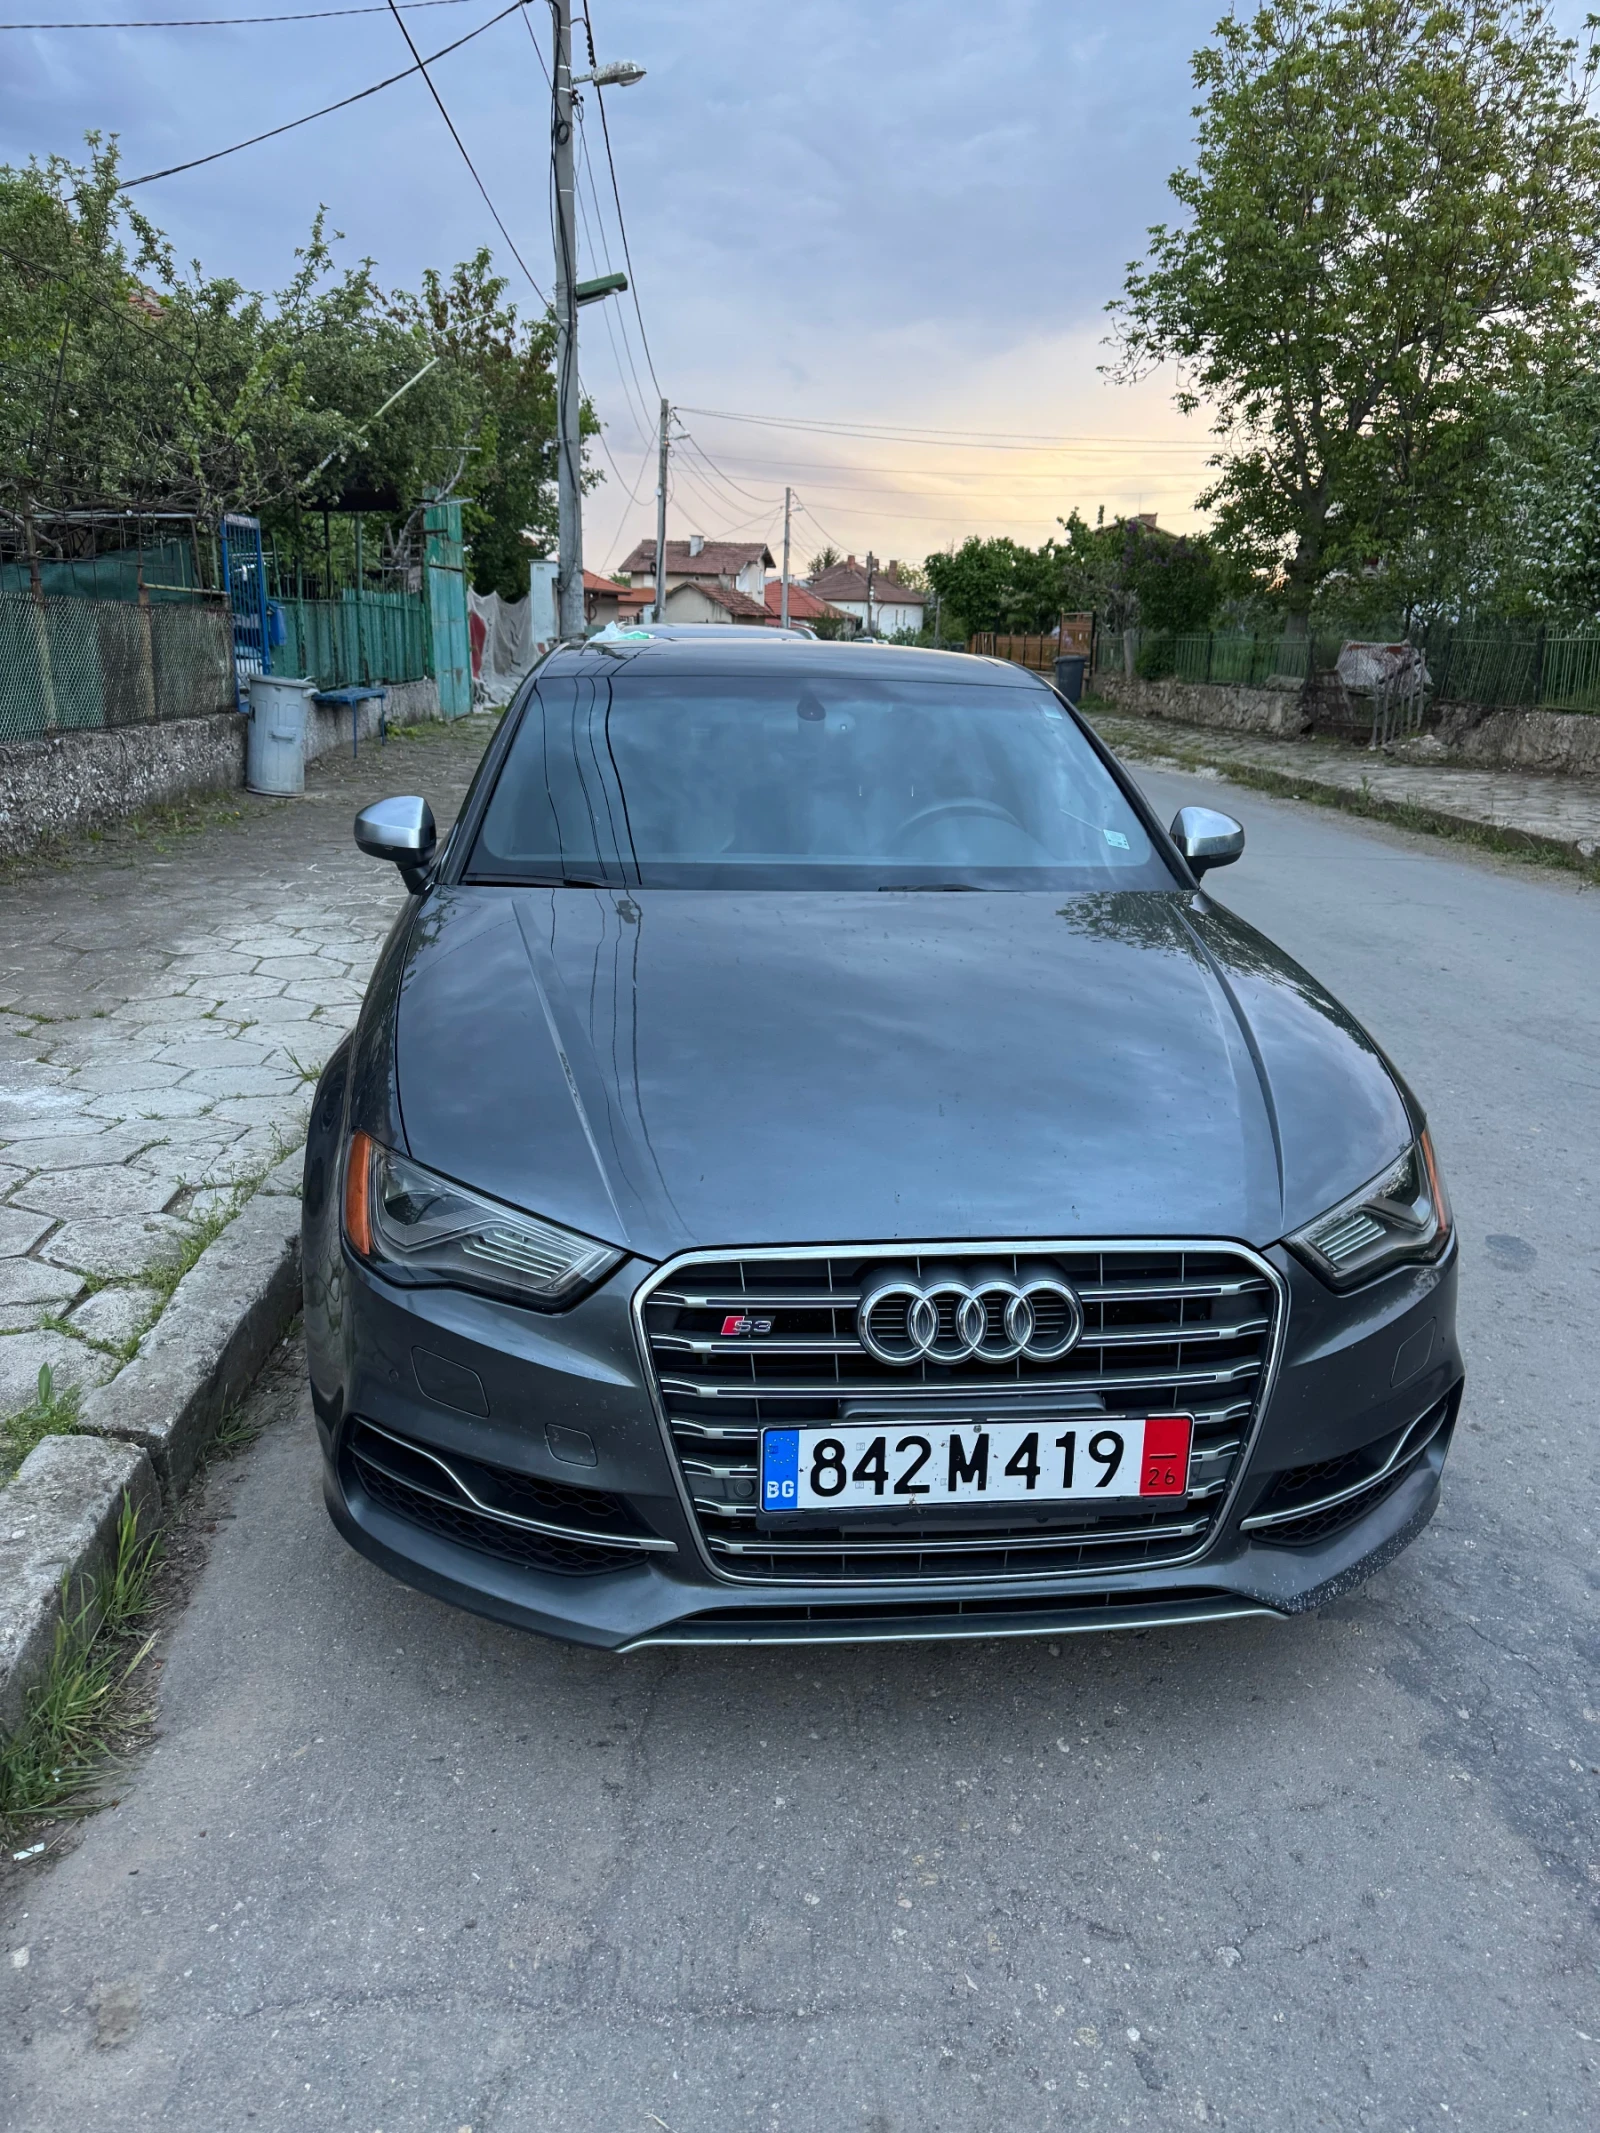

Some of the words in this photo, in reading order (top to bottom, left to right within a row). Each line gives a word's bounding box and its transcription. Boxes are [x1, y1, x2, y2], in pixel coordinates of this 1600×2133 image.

[733, 1320, 772, 1333] S3
[1147, 1467, 1176, 1486] 26
[766, 1480, 795, 1498] BG
